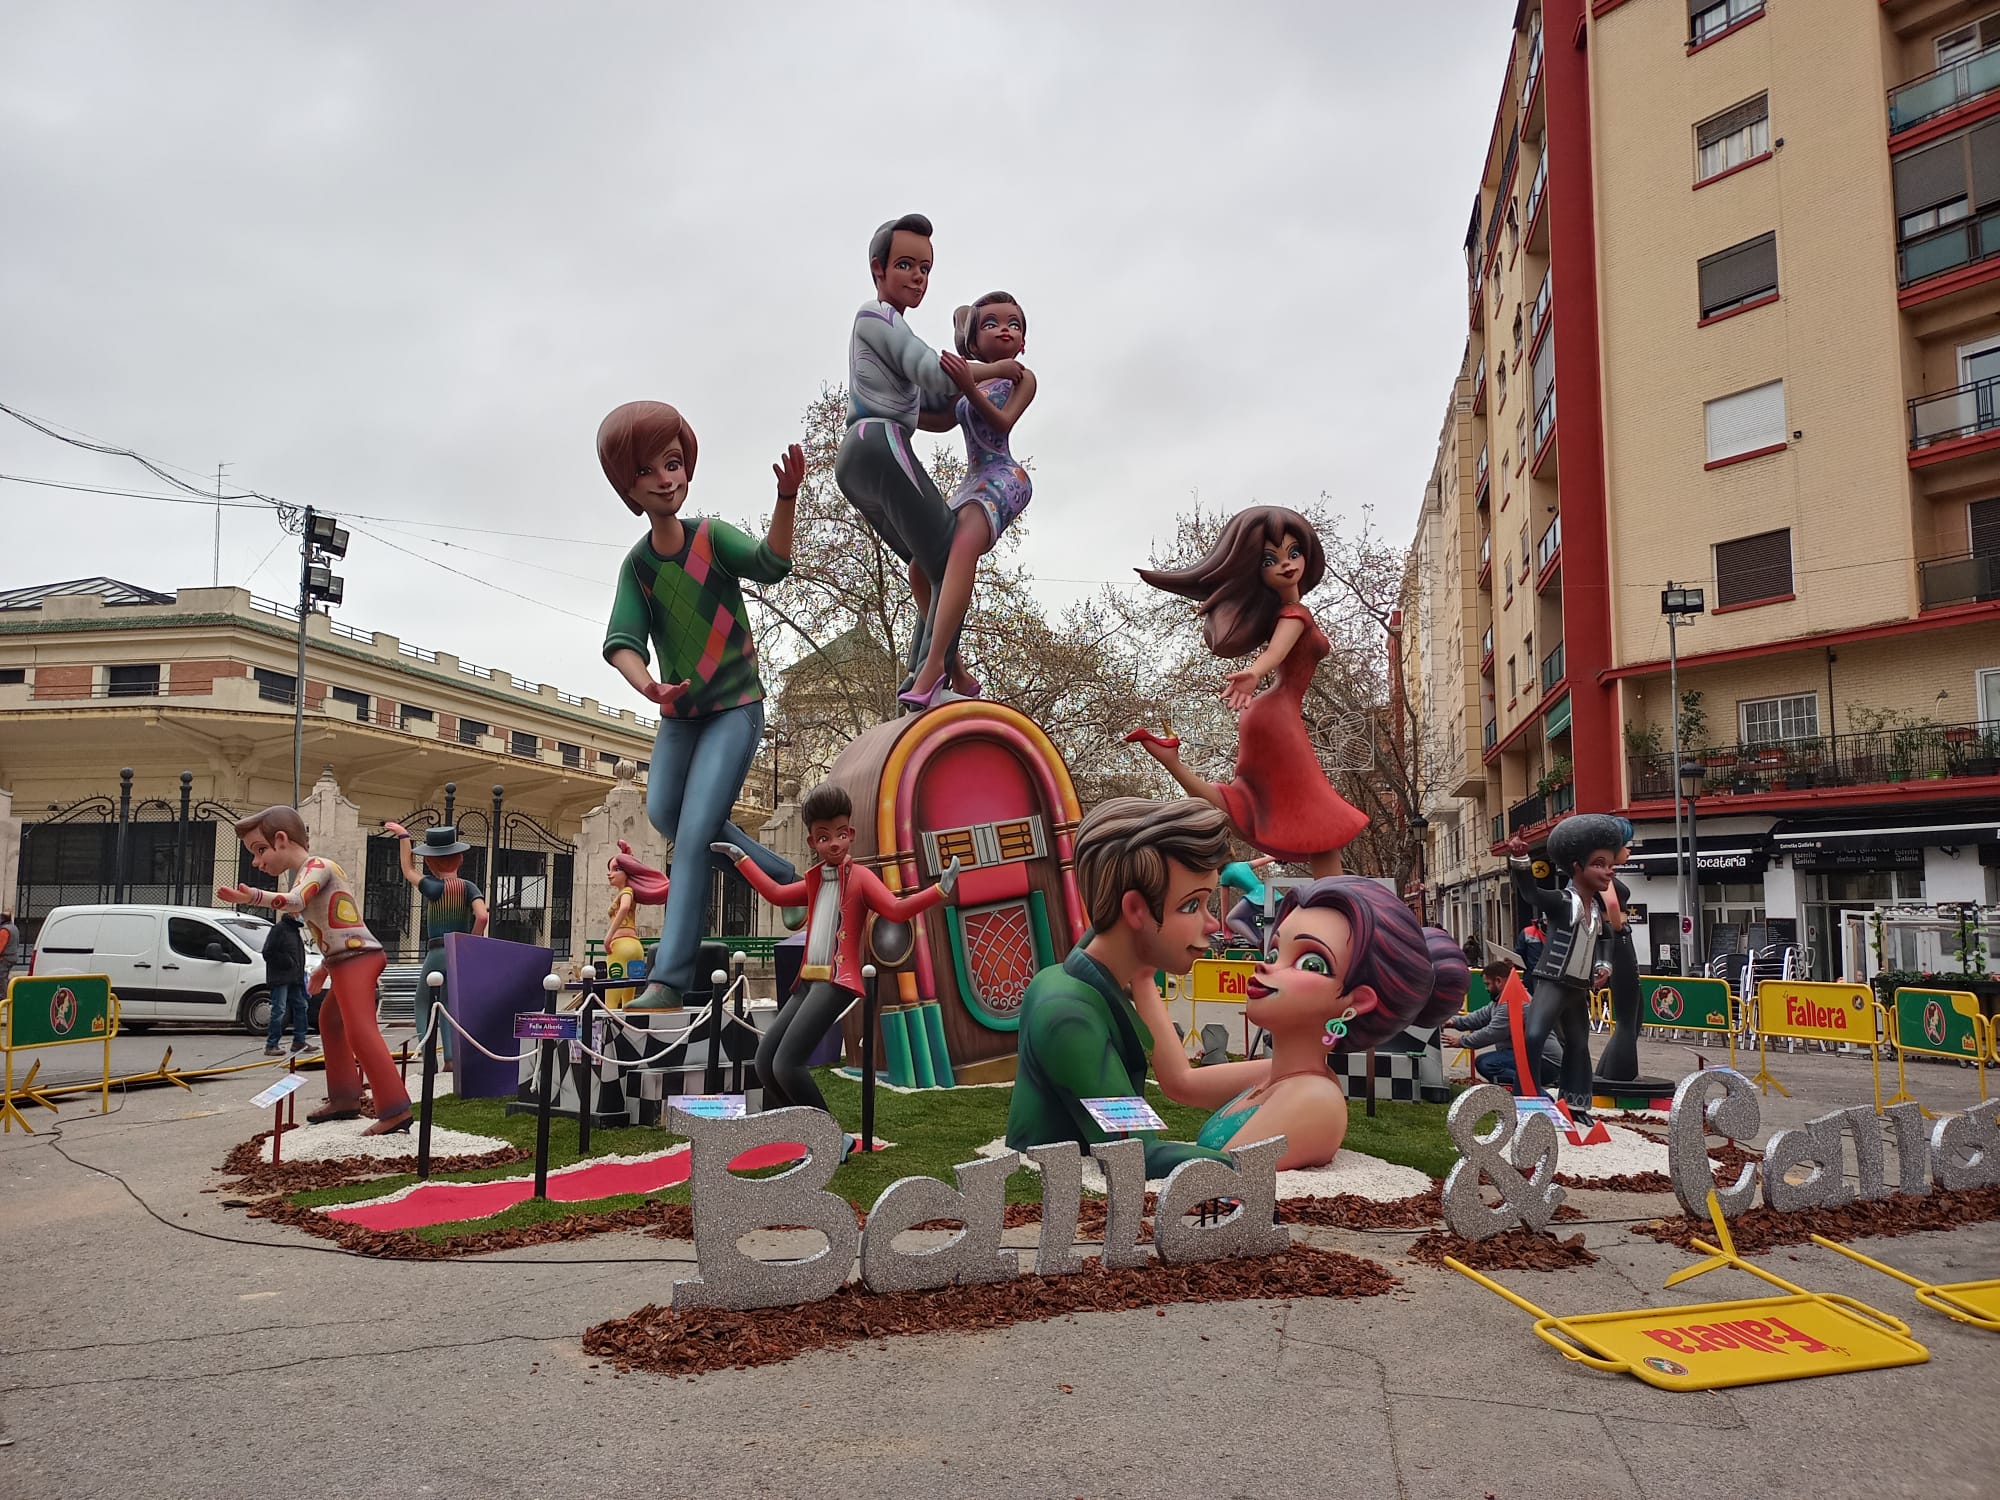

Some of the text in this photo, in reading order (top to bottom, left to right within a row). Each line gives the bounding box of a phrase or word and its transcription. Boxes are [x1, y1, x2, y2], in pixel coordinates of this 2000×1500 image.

[1218, 969, 1247, 994] Fall
[1786, 996, 1847, 1030] Fallera
[668, 1105, 1289, 1313] Balla
[1442, 1083, 1568, 1242] &
[1641, 1316, 1828, 1355] Fallera
